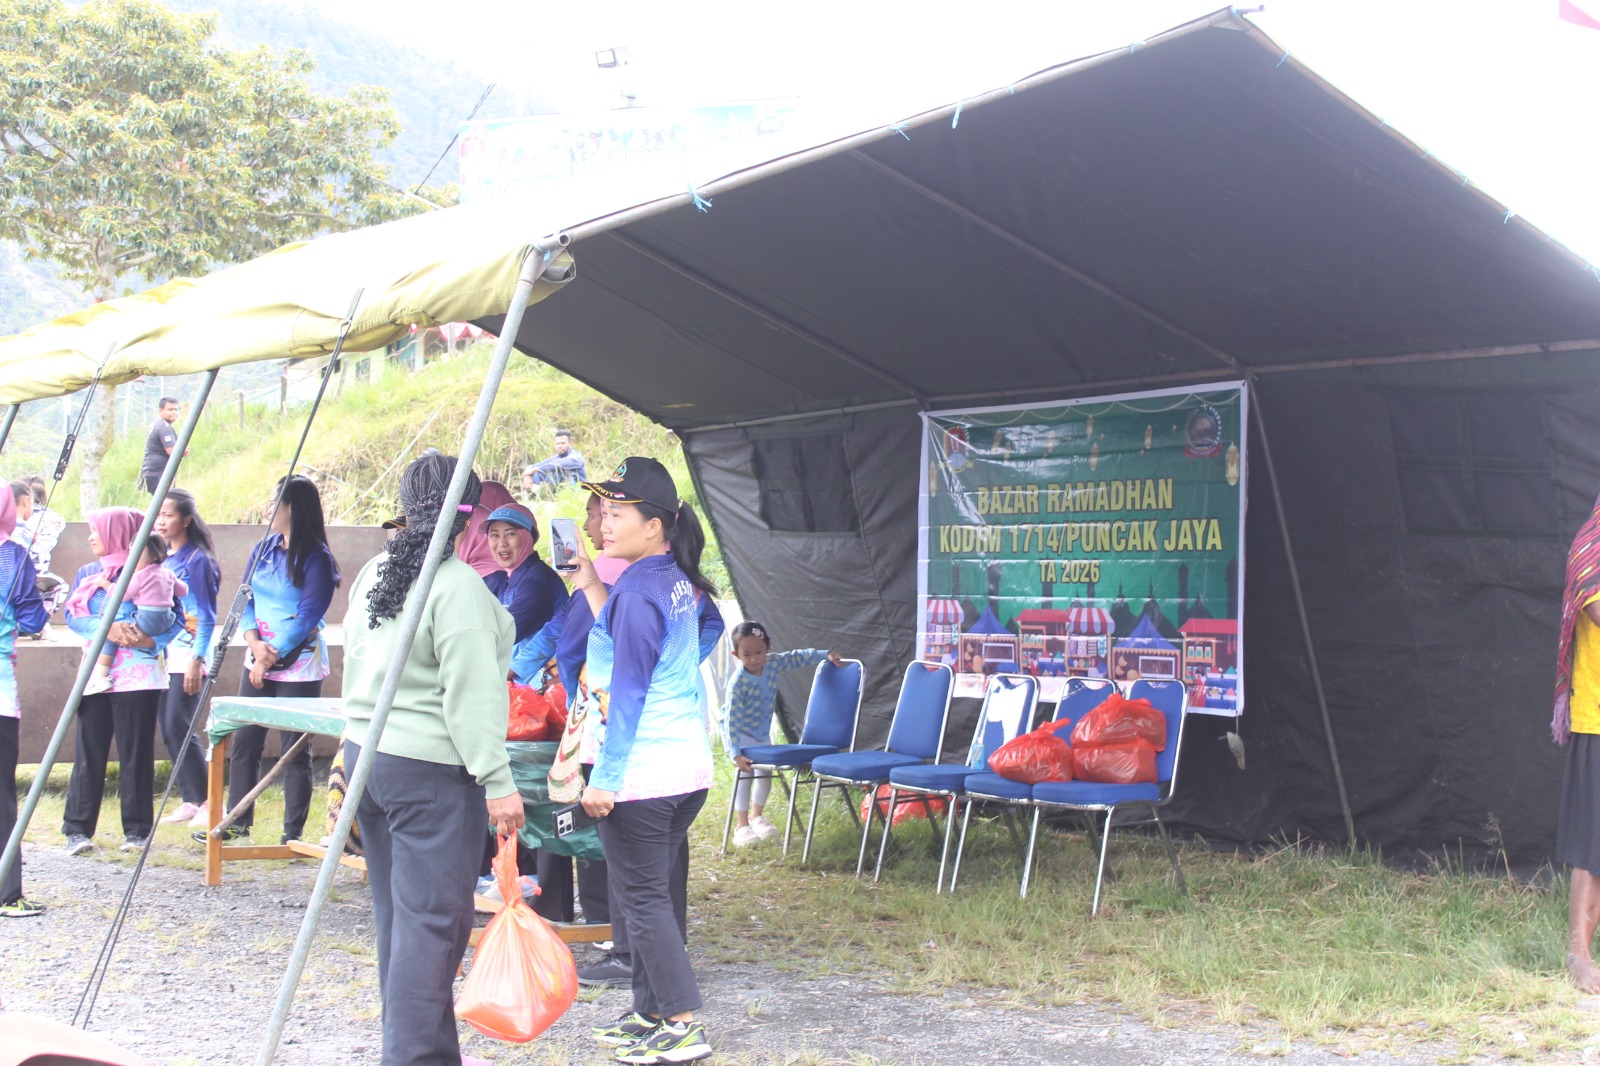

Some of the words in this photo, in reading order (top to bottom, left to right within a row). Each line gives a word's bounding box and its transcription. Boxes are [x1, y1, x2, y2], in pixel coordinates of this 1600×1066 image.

[977, 484, 1040, 516] BAZAR
[1046, 478, 1174, 514] RAMADHAN
[939, 523, 1002, 554] KODIM
[1008, 519, 1158, 556] 1714/PUNCAK
[1163, 518, 1223, 552] JAYA
[1039, 559, 1058, 583] TA
[1060, 559, 1100, 583] 2026
